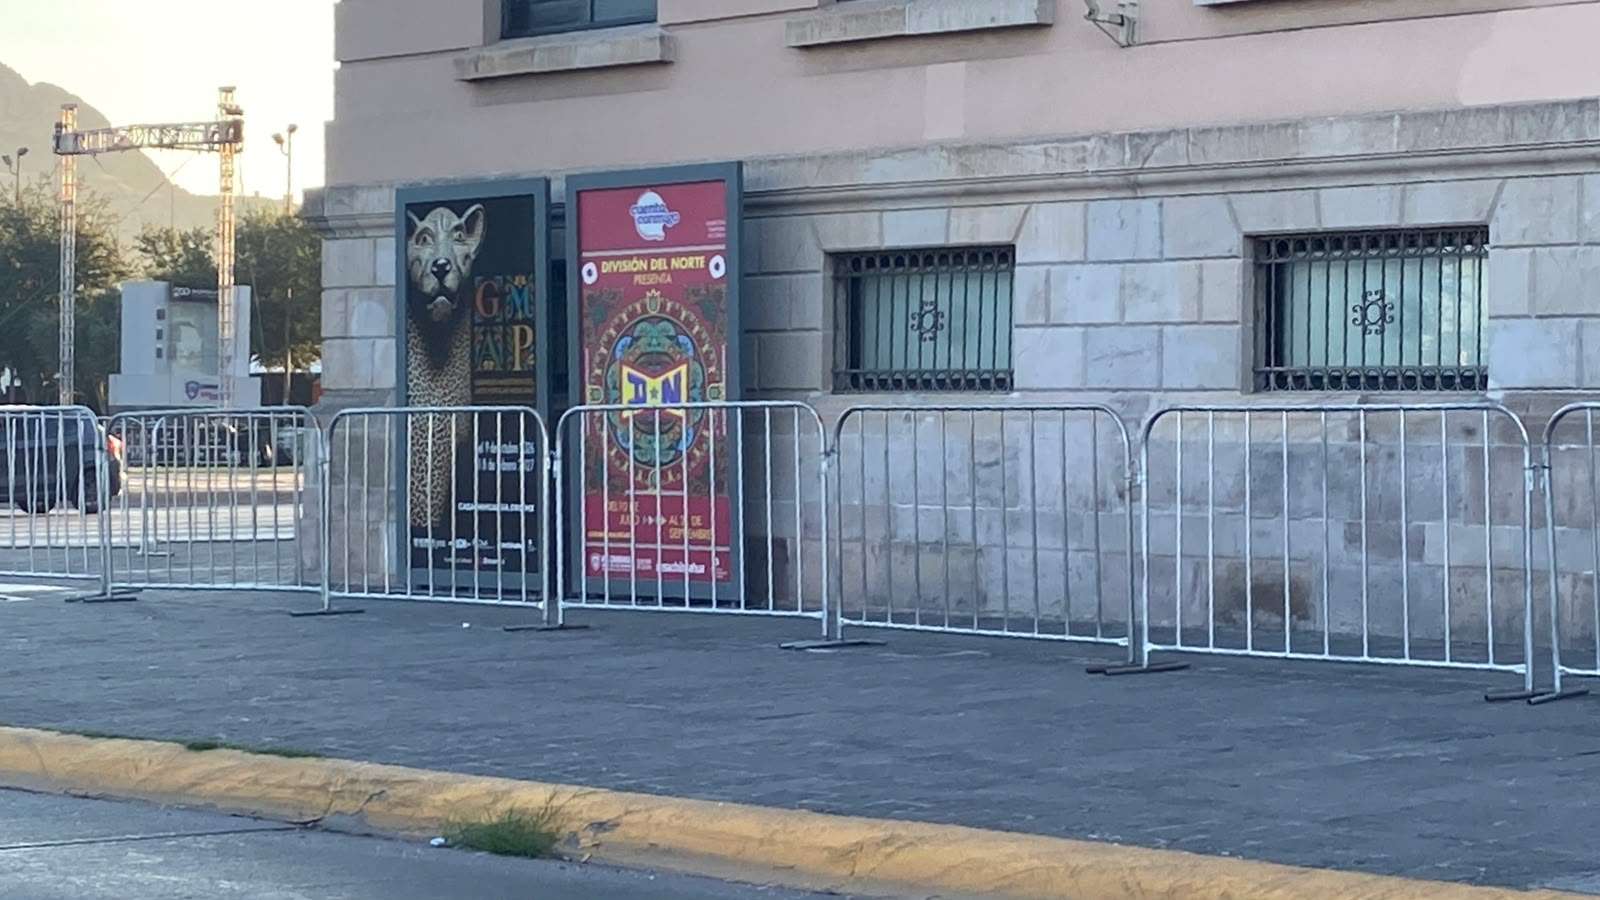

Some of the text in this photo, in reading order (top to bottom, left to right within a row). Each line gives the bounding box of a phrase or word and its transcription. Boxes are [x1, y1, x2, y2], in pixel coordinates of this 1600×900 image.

[601, 255, 706, 274] DIVISIÓN DEL NORTE
[633, 272, 673, 286] PRESENTA
